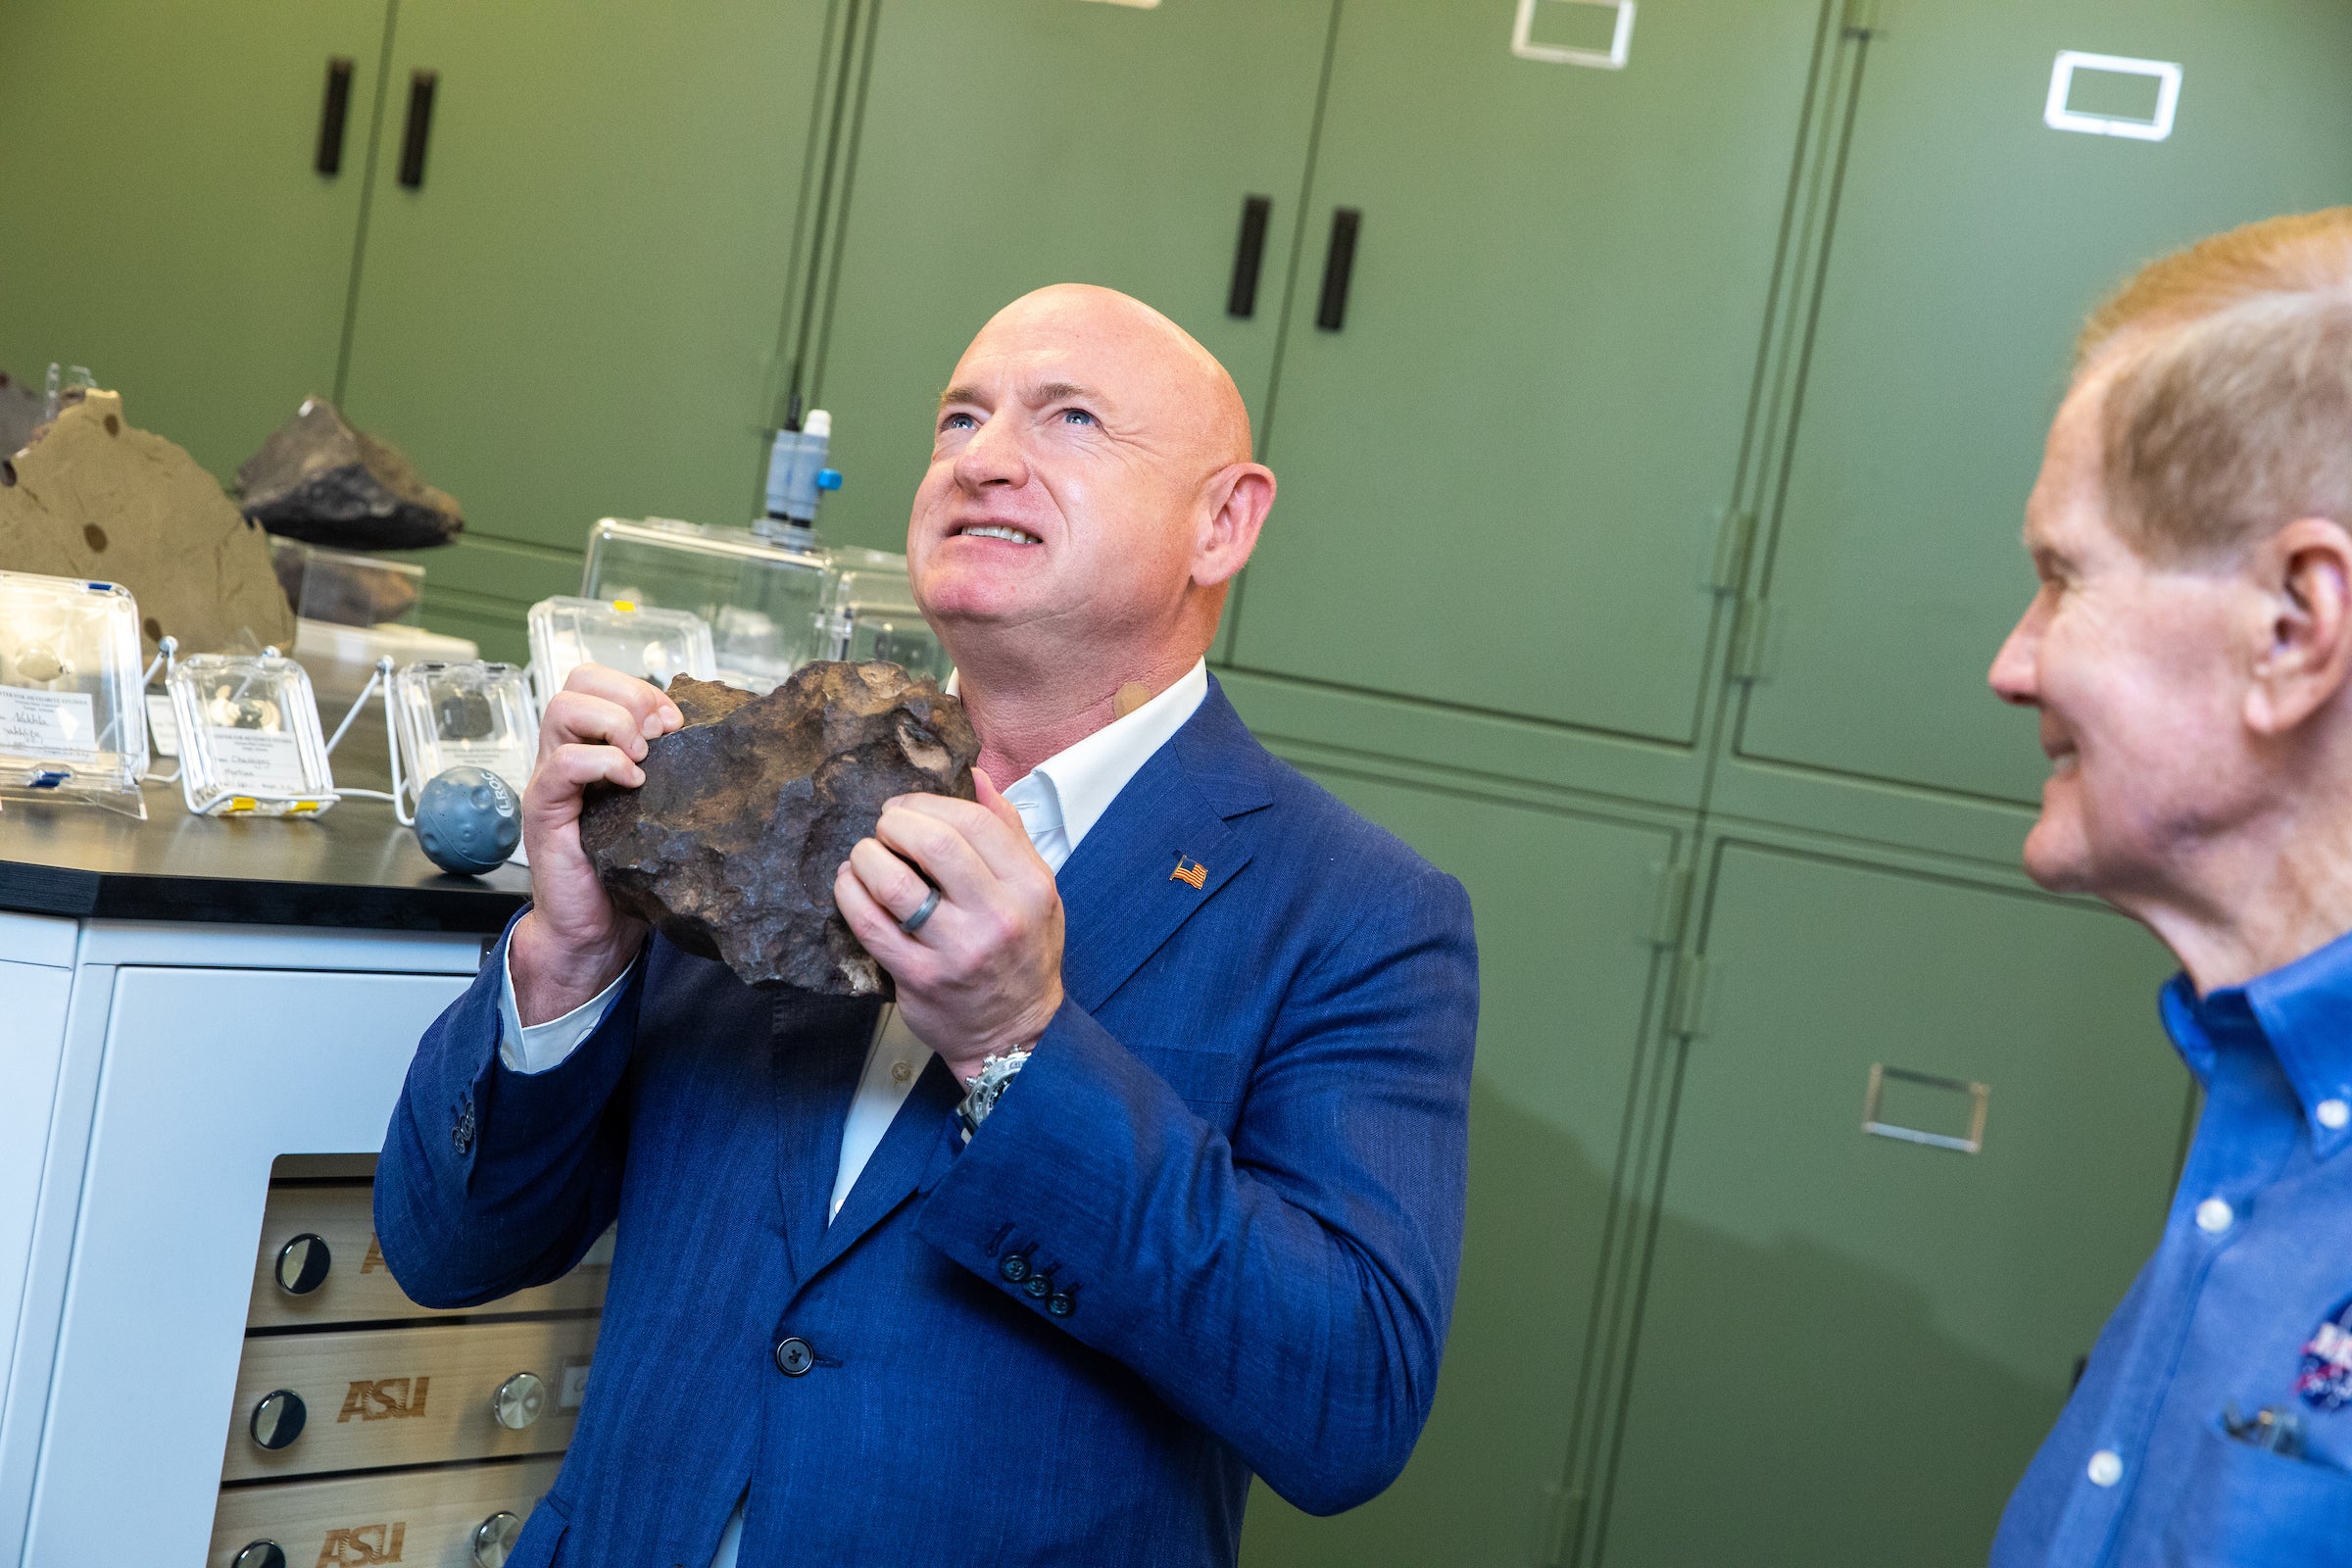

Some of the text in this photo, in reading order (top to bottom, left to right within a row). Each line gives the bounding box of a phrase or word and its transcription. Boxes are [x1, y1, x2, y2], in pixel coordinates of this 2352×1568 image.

[480, 770, 513, 811] LROC
[337, 1376, 429, 1423] ASU
[315, 1522, 407, 1568] ASU
